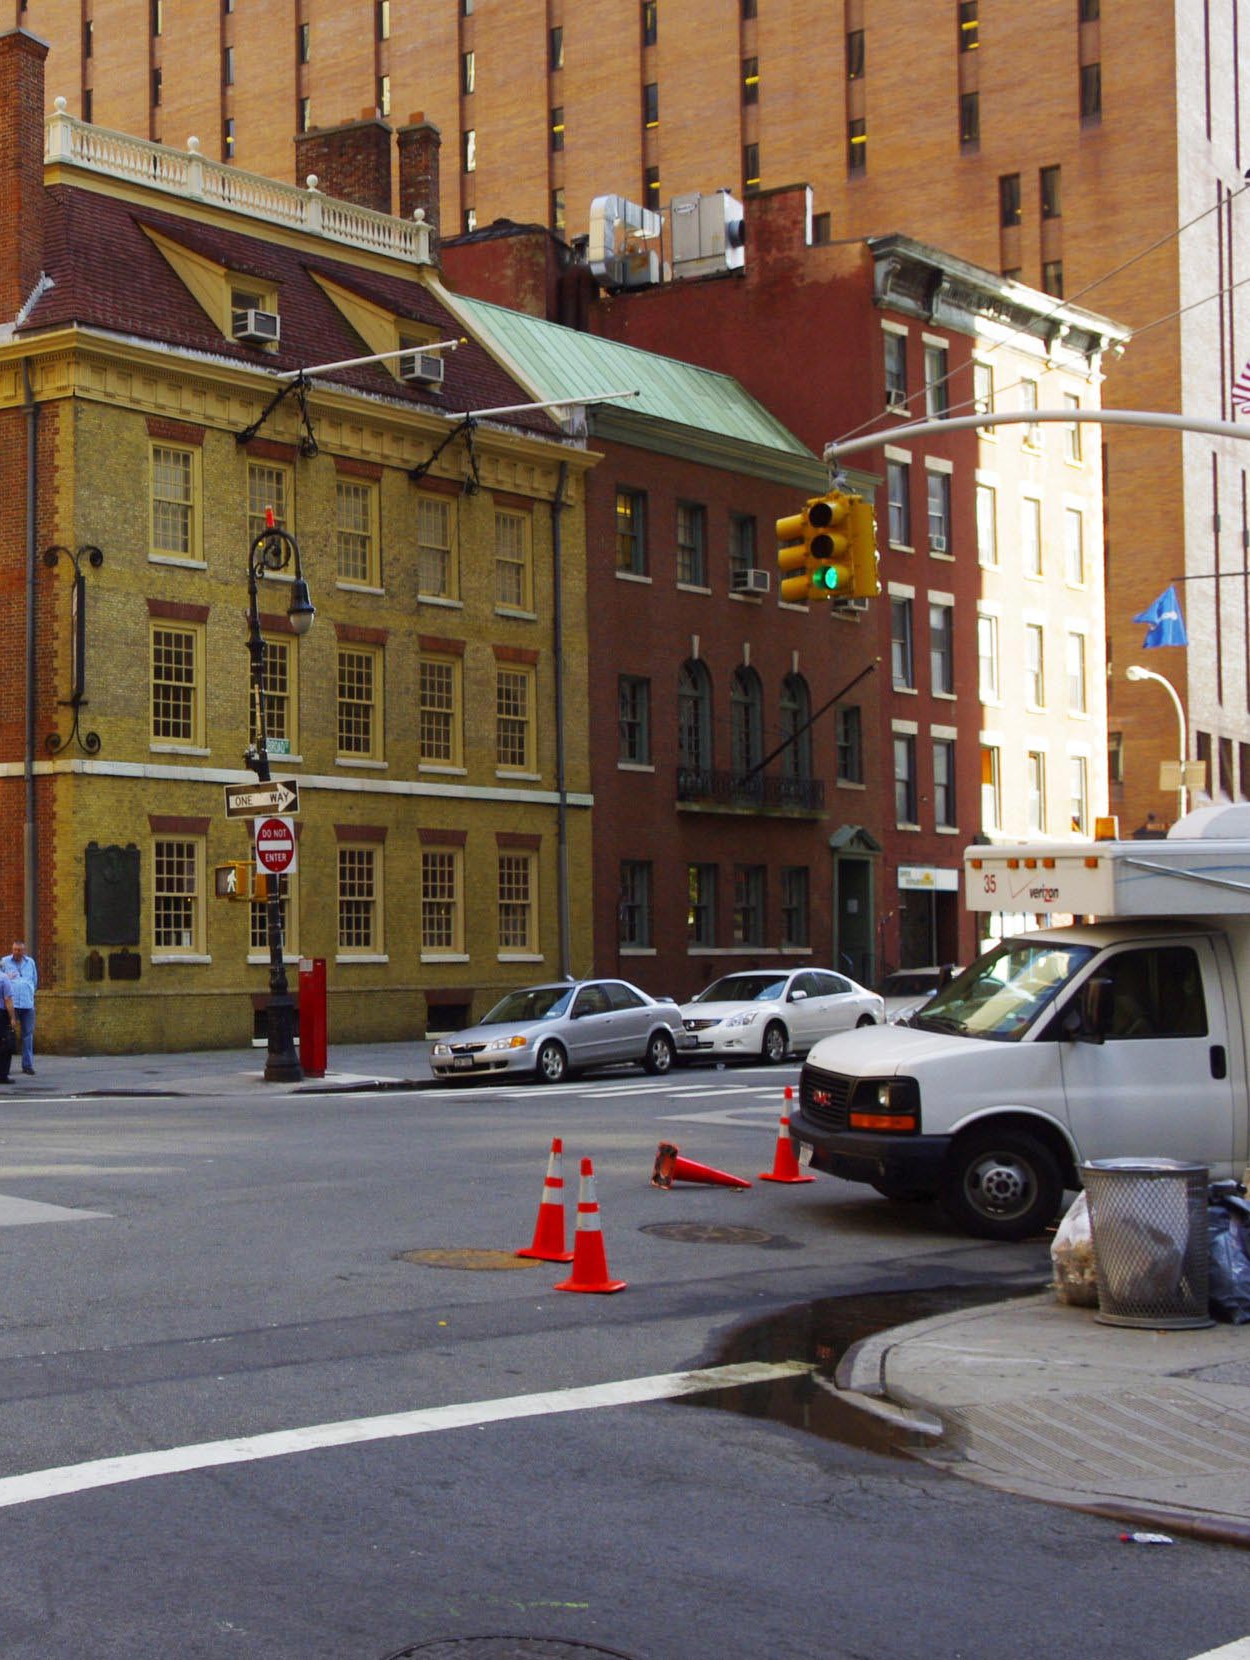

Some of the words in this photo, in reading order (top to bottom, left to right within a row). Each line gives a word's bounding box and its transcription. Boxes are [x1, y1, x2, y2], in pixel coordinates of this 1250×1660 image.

[235, 795, 253, 807] ONE
[270, 792, 289, 803] WAY
[262, 829, 272, 838] DO
[273, 829, 287, 838] NOT
[265, 853, 287, 862] ENTER
[983, 874, 997, 894] 35
[1029, 884, 1059, 902] verizon
